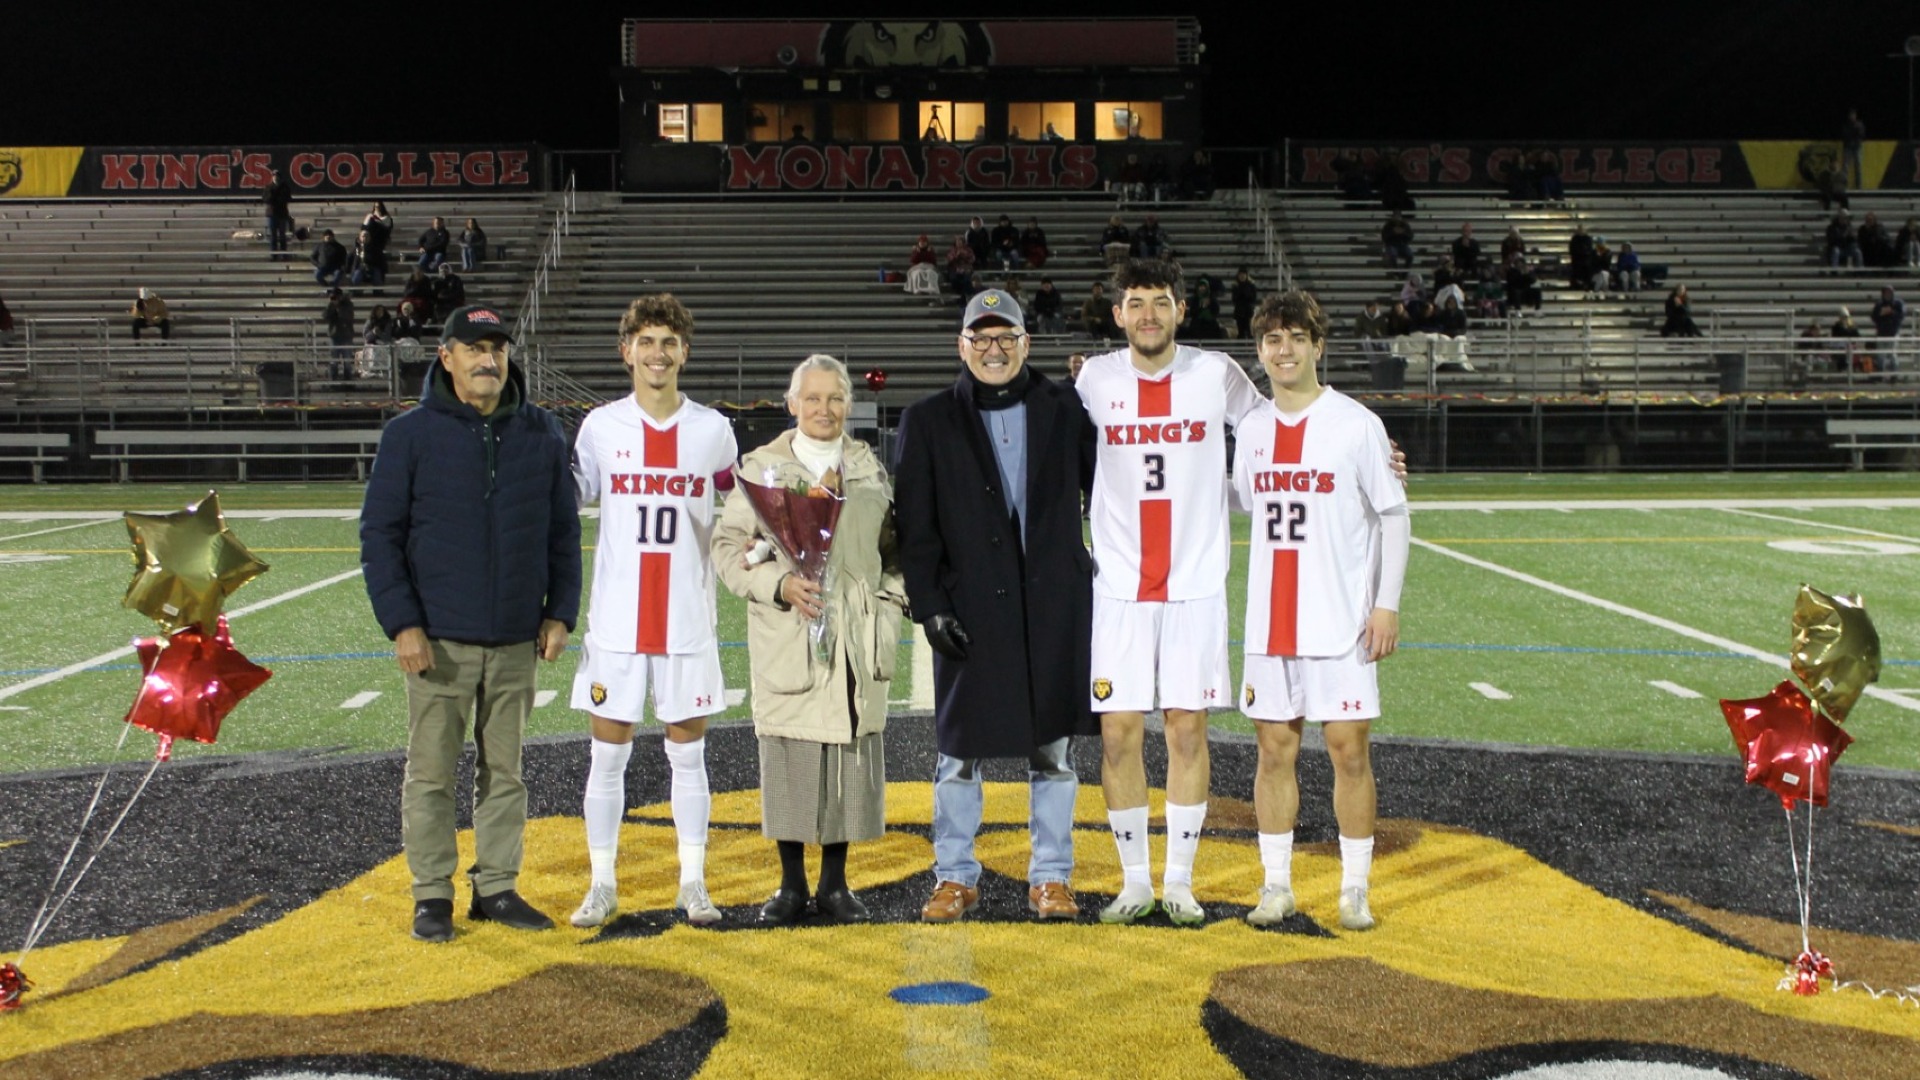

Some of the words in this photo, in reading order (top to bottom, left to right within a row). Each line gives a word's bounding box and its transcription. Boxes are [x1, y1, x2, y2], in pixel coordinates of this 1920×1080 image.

[101, 149, 274, 189] KING'S
[290, 151, 529, 188] COLLEGE
[727, 145, 1098, 190] MONARCHS
[1301, 143, 1472, 183] KG'S
[1104, 419, 1206, 445] KING'S
[610, 473, 706, 498] KING'S
[1143, 453, 1166, 493] 3
[1254, 469, 1335, 494] KING'S
[636, 504, 679, 545] 10
[1265, 501, 1308, 543] 22
